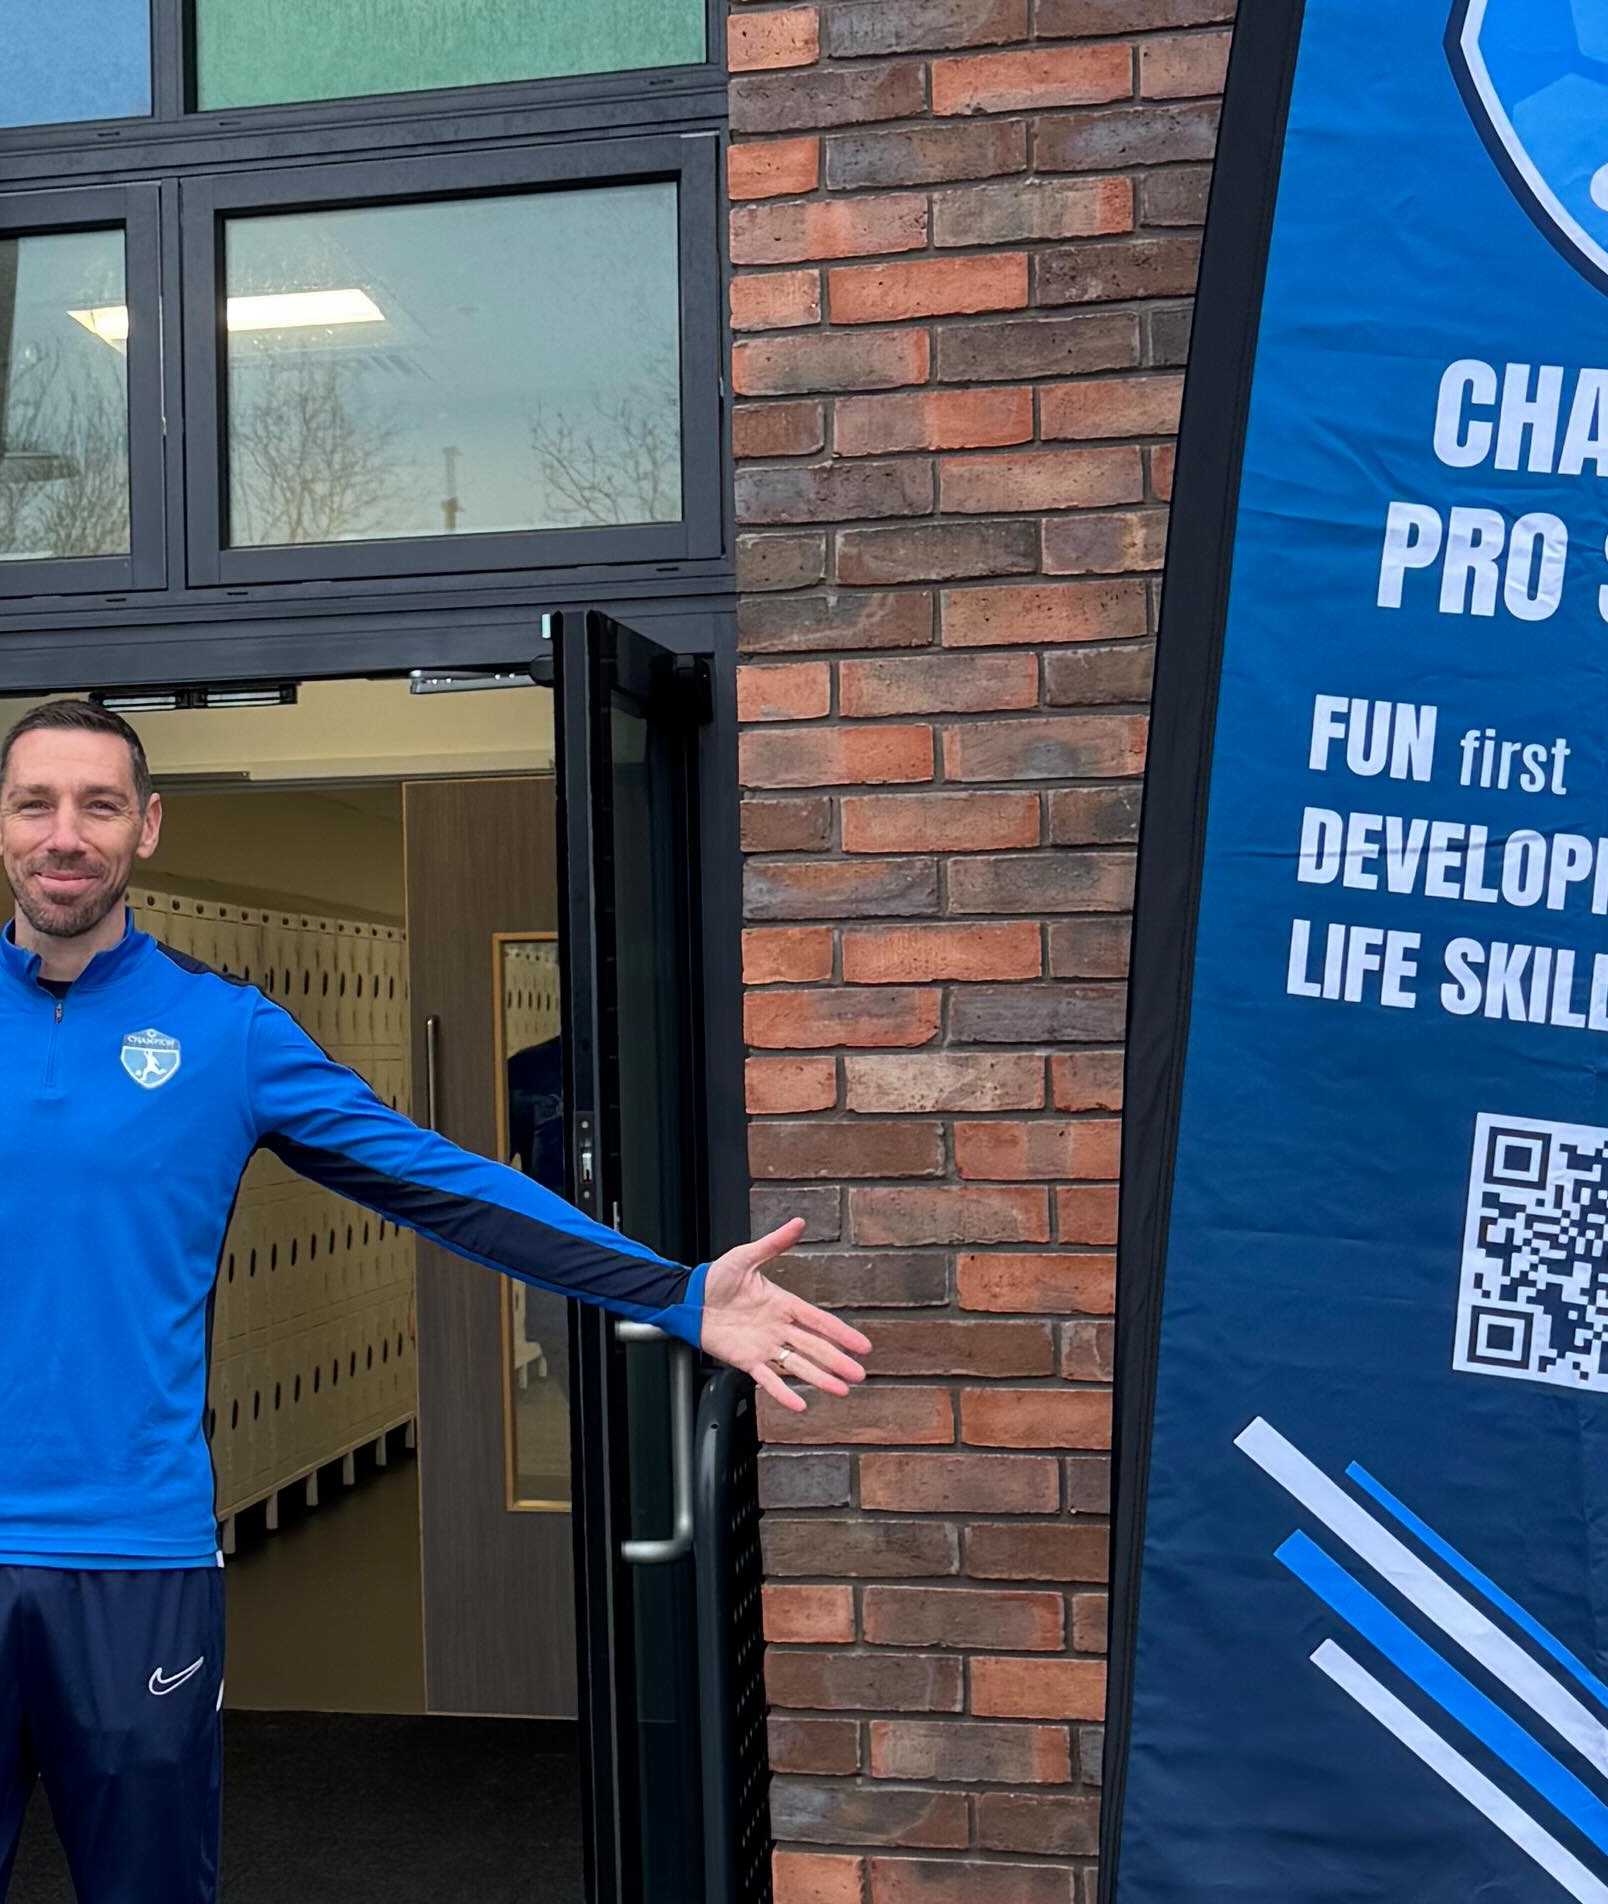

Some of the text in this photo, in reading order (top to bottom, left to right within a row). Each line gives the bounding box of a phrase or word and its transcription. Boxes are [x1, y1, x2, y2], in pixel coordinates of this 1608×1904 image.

[1432, 358, 1608, 477] CHA
[1377, 501, 1569, 621] PRO
[1308, 694, 1572, 796] FUN first
[1286, 918, 1422, 1009] LIFE
